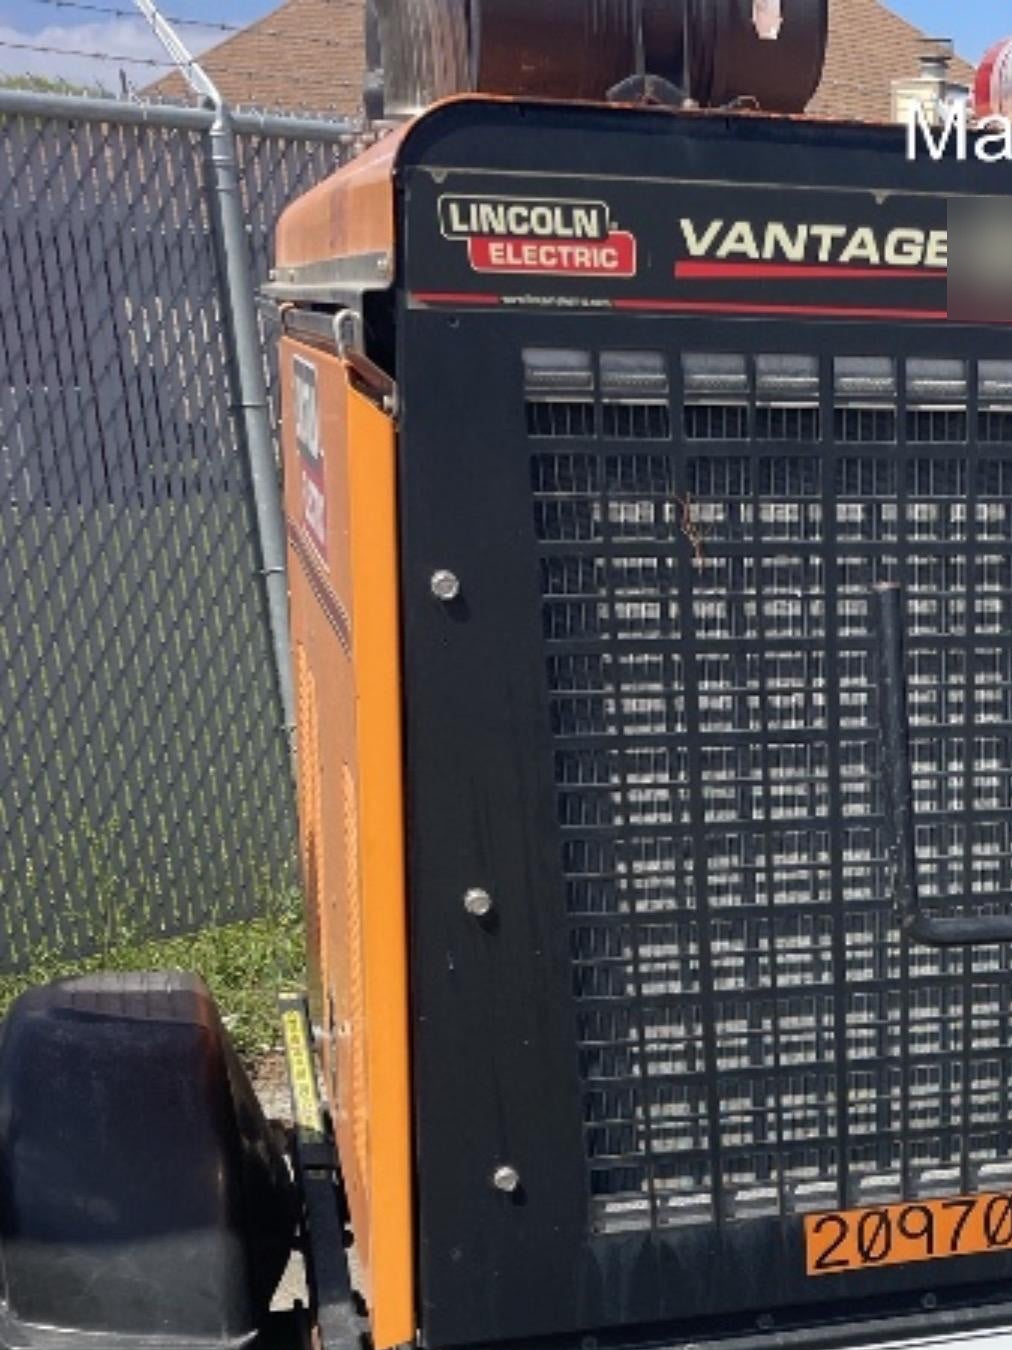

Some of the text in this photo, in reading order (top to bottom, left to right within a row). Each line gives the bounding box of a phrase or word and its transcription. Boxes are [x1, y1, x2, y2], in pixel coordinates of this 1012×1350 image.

[449, 203, 600, 238] LINCOLN
[488, 241, 619, 268] ELECTRIC
[679, 217, 948, 267] VANTAGE
